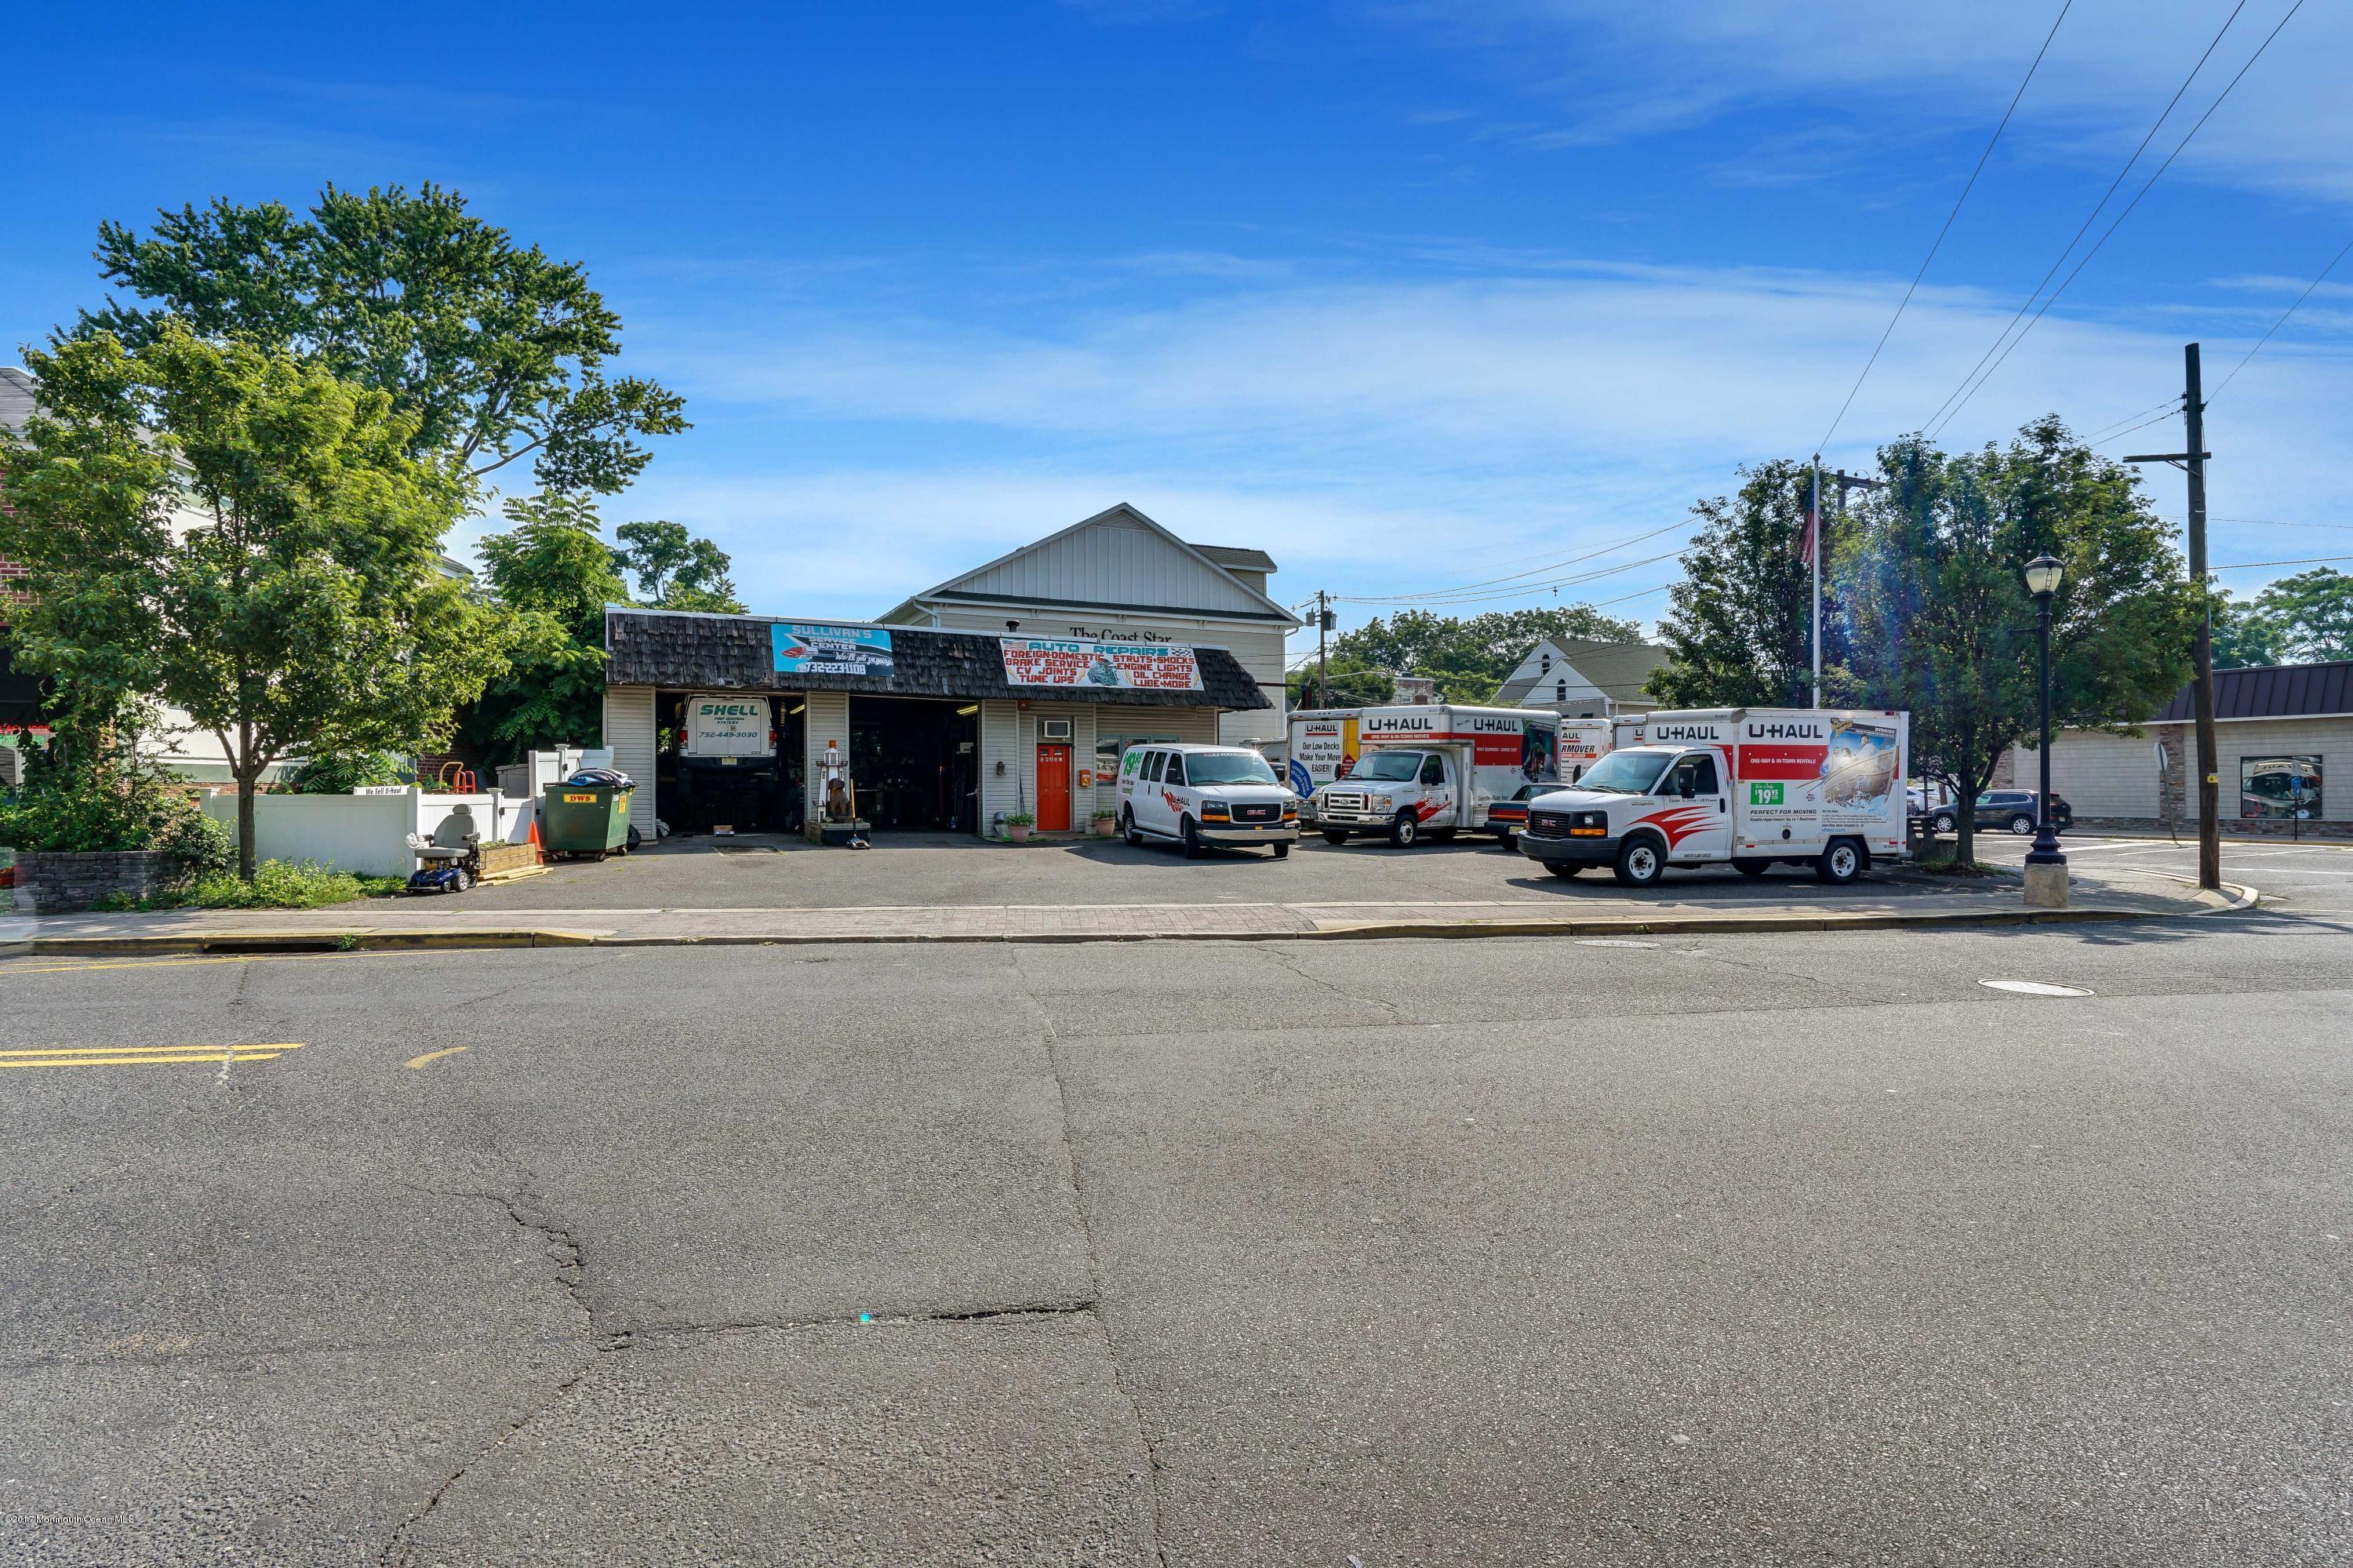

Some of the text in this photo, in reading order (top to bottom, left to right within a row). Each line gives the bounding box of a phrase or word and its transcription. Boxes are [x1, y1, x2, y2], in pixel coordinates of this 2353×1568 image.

[792, 625, 872, 638] SULLIVAN'S
[811, 642, 856, 650] CENTER
[1028, 642, 1168, 656] AUTO REPAIRS
[856, 653, 867, 663] get
[806, 662, 867, 675] 732-223-1108
[1045, 660, 1089, 668] SERVICE
[1020, 675, 1075, 684] TUNE UPS
[700, 704, 758, 715] SHELL
[1369, 718, 1433, 730] U-HAUL
[1474, 719, 1518, 732] U-HAUL
[1657, 726, 1719, 740] U-HAUL
[1748, 724, 1824, 739] U-HAUL
[1323, 742, 1340, 751] Decks
[1327, 753, 1342, 762] Move
[1311, 764, 1332, 773] EASIER!
